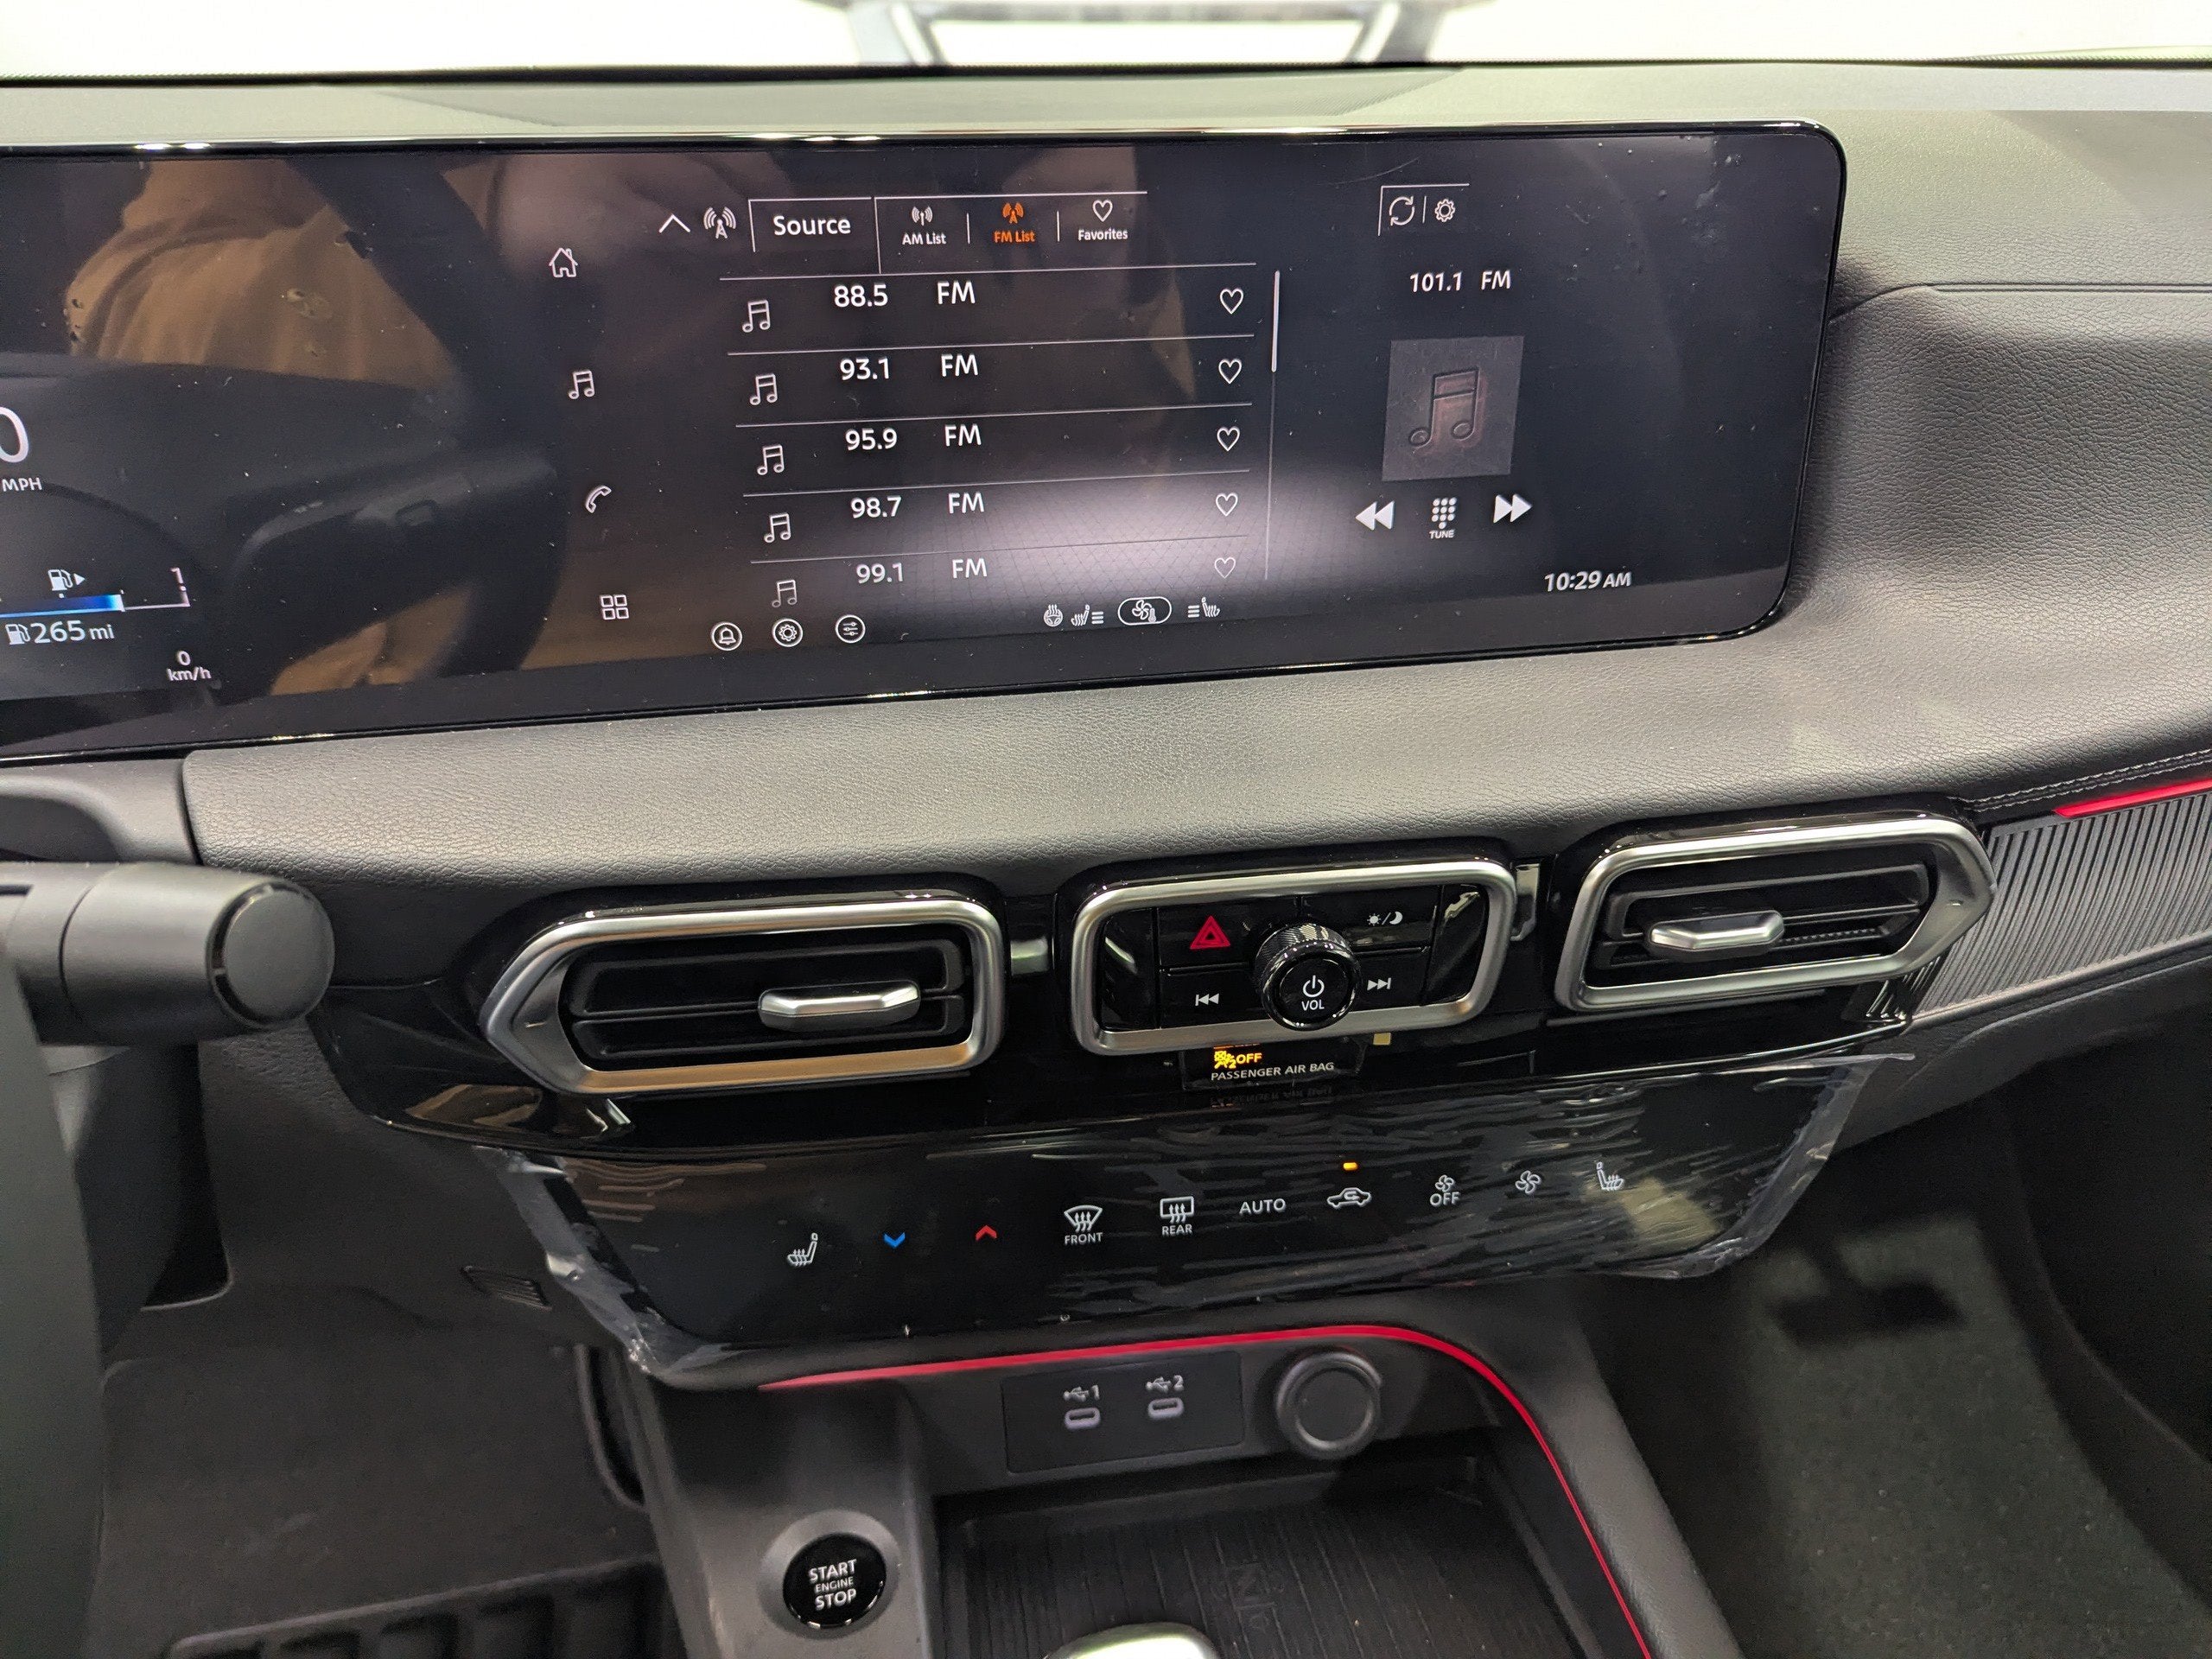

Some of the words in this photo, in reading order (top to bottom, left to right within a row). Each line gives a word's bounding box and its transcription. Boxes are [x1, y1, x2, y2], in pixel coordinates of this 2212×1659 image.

[772, 215, 851, 236] Source
[901, 232, 924, 245] AM
[925, 232, 947, 245] List
[994, 230, 1013, 244] FM
[1014, 230, 1035, 243] List
[1077, 227, 1128, 241] Favorites
[1409, 271, 1462, 292] 101.1
[1481, 270, 1511, 290] FM
[834, 283, 888, 308] 88.5
[937, 281, 976, 305] FM
[839, 357, 890, 380] 93.1
[940, 353, 979, 377] FM
[845, 427, 898, 451] 95.9
[944, 423, 982, 447] FM
[1, 477, 43, 493] MPH
[850, 495, 902, 518] 98.7
[948, 492, 985, 514] FM
[1428, 529, 1455, 539] TUNE
[855, 562, 904, 584] 99.1
[951, 557, 988, 579] FM
[1543, 570, 1602, 592] 10:29
[1602, 571, 1632, 588] AM
[30, 620, 86, 644] 265
[89, 624, 115, 640] mi
[176, 651, 191, 666] 0
[166, 666, 212, 682] km/h
[1301, 999, 1325, 1011] VOL
[1236, 1052, 1262, 1065] OFF
[1211, 1066, 1281, 1081] PASSENGER
[1285, 1064, 1306, 1075] AIR
[1310, 1061, 1335, 1073] BAG
[1239, 1198, 1287, 1215] AUTO
[1429, 1192, 1460, 1207] OFF
[1064, 1231, 1103, 1245] FRONT
[1161, 1224, 1192, 1236] REAR
[1173, 1375, 1184, 1391] 2
[1091, 1384, 1100, 1400] 1
[809, 1559, 857, 1582] START
[815, 1576, 855, 1593] ENGINE
[816, 1588, 857, 1611] STOP
